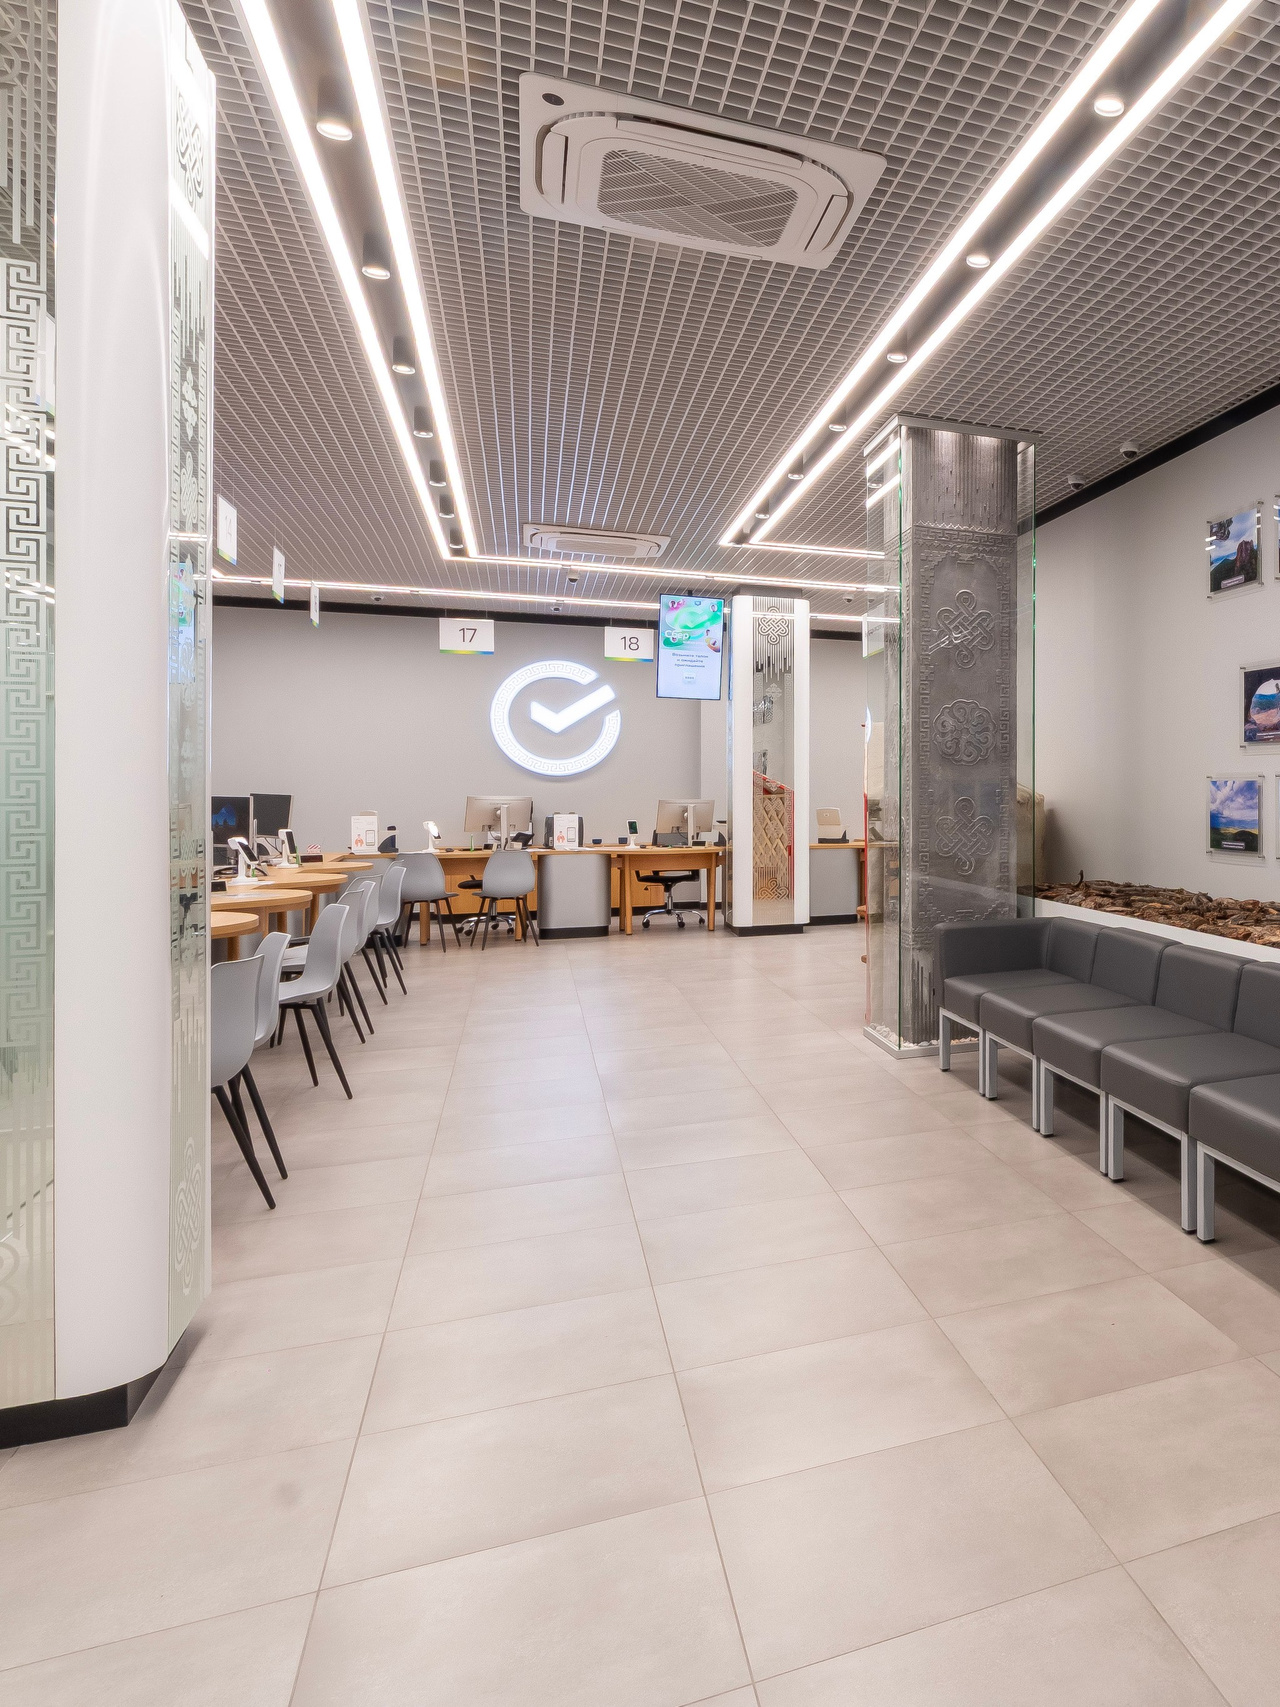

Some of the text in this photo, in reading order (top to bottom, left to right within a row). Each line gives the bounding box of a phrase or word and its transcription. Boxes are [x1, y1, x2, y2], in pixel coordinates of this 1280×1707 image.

[458, 627, 478, 643] 17
[665, 630, 689, 640] Сбер
[620, 636, 640, 651] 18
